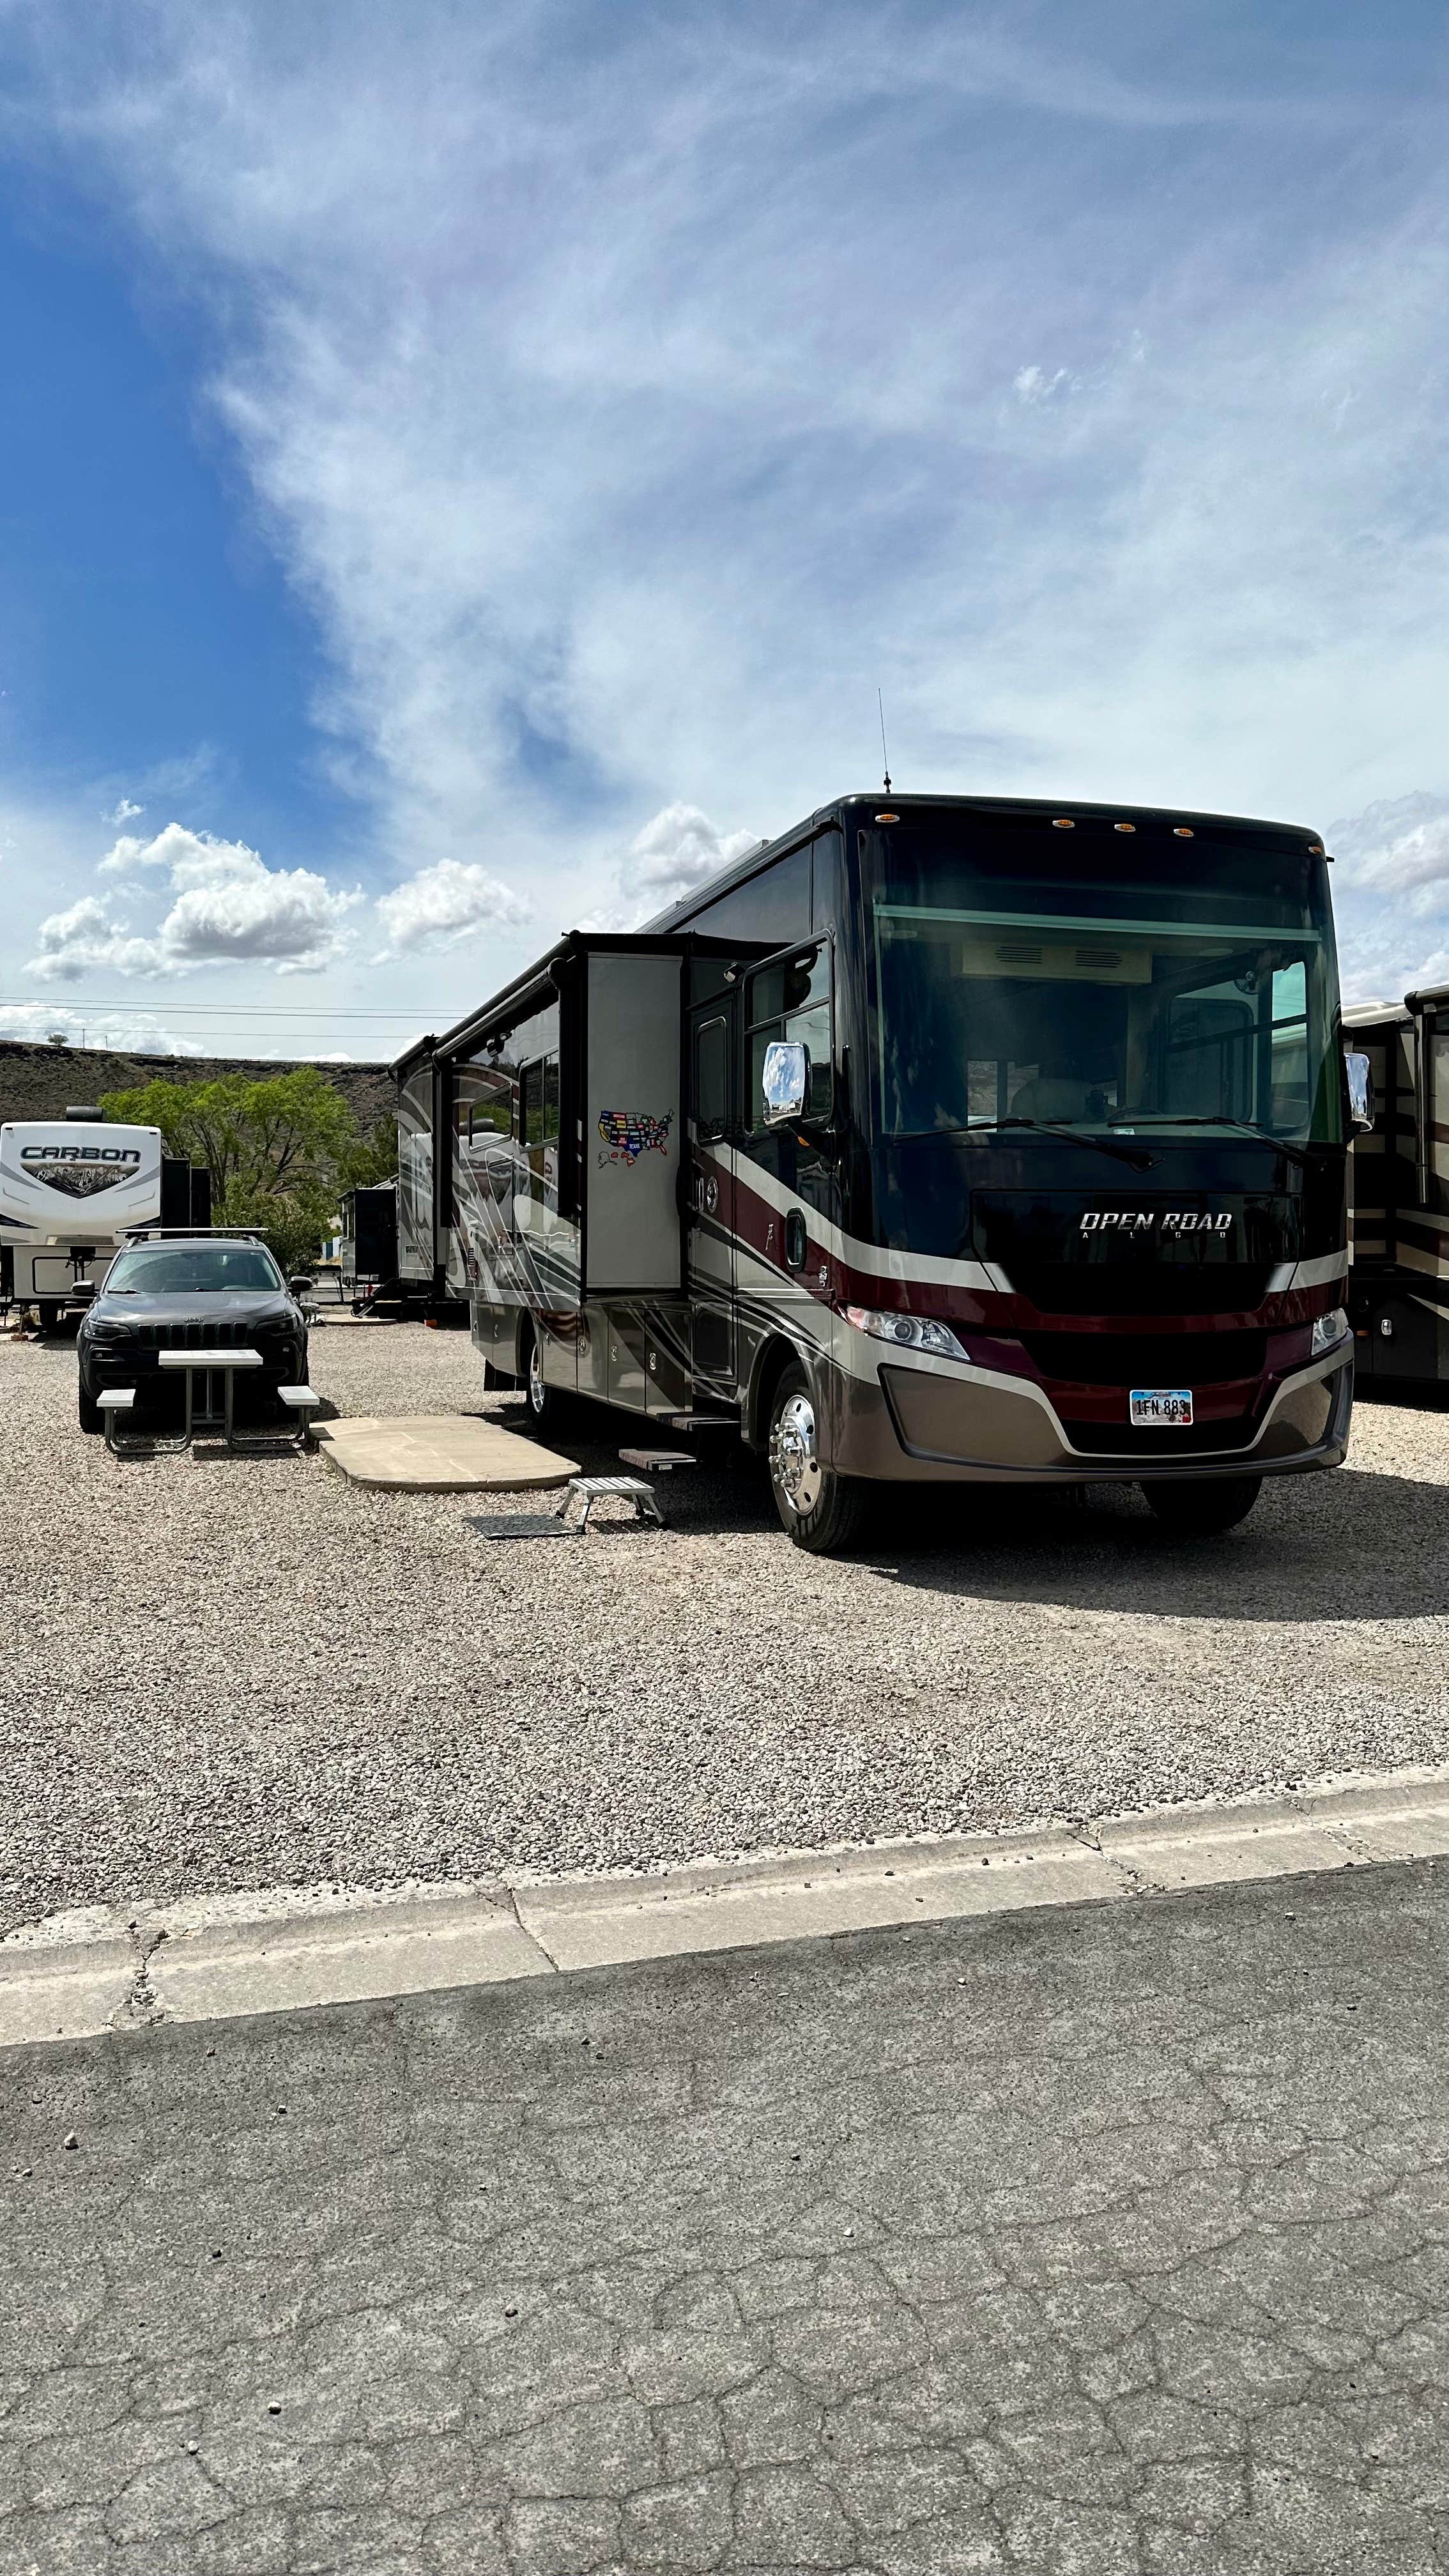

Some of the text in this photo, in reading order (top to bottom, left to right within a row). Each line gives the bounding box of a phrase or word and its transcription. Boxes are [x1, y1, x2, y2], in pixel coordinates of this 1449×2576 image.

[20, 1147, 141, 1163] CARBON
[1080, 1213, 1232, 1230] OPEN ROAD
[1136, 1399, 1186, 1415] 1FN 883
